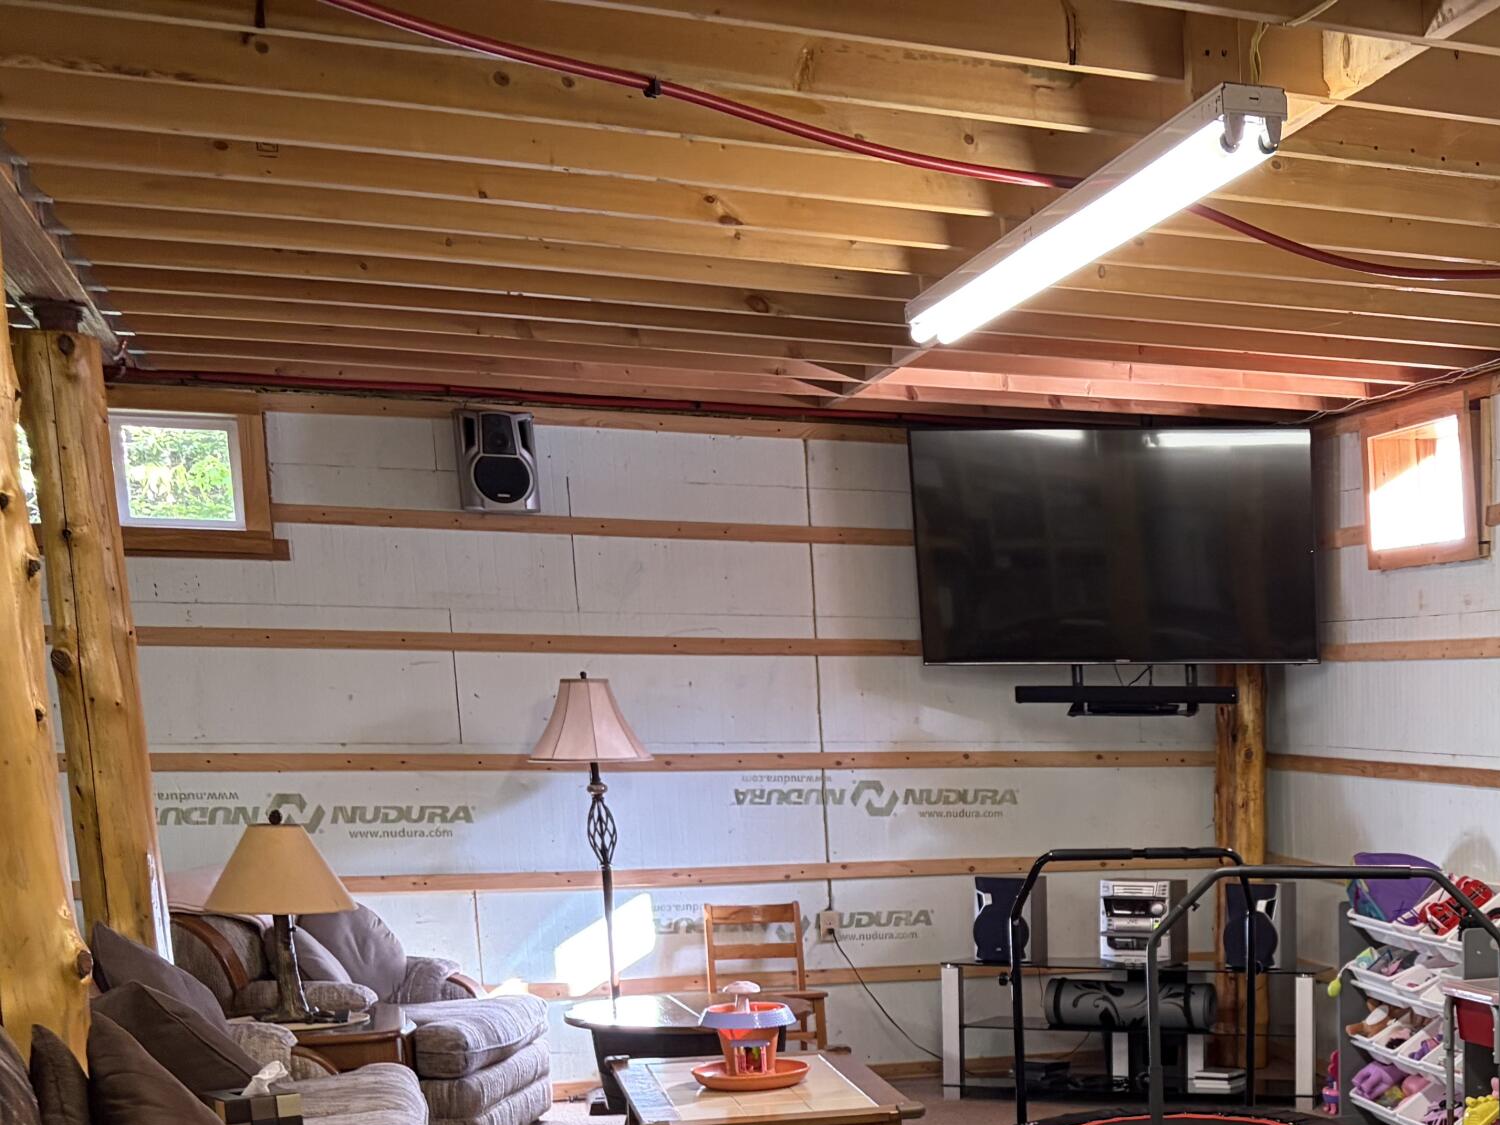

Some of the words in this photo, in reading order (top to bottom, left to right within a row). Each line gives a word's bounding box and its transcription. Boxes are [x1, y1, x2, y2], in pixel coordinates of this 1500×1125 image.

[735, 788, 846, 805] NUDURA
[904, 788, 1018, 805] NUDURA
[154, 806, 260, 826] NUDU
[330, 805, 474, 824] NUDURA
[919, 808, 1003, 818] www.nudura.com
[349, 828, 453, 839] www.nudura.com
[816, 910, 932, 928] UDURA
[839, 931, 918, 942] ww.nudura.com
